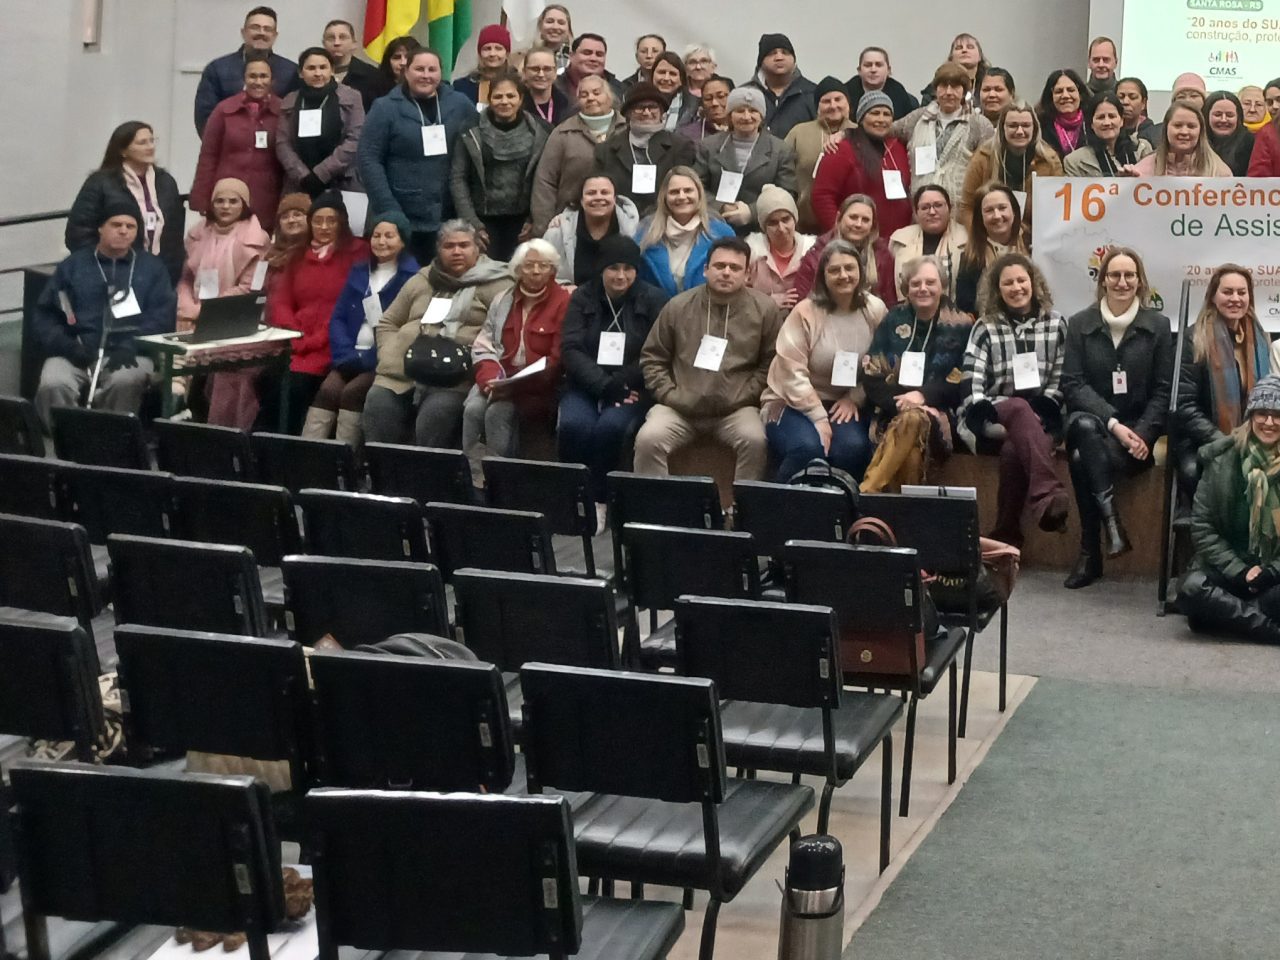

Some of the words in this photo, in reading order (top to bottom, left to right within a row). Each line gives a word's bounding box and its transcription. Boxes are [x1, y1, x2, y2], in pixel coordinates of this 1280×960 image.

[1219, 0, 1243, 9] ROSA
[1249, 1, 1262, 10] RS
[1209, 19, 1239, 29] anos
[1242, 18, 1258, 30] do
[1209, 66, 1237, 76] CMAS
[1054, 182, 1119, 222] 16ª
[1170, 213, 1203, 237] de
